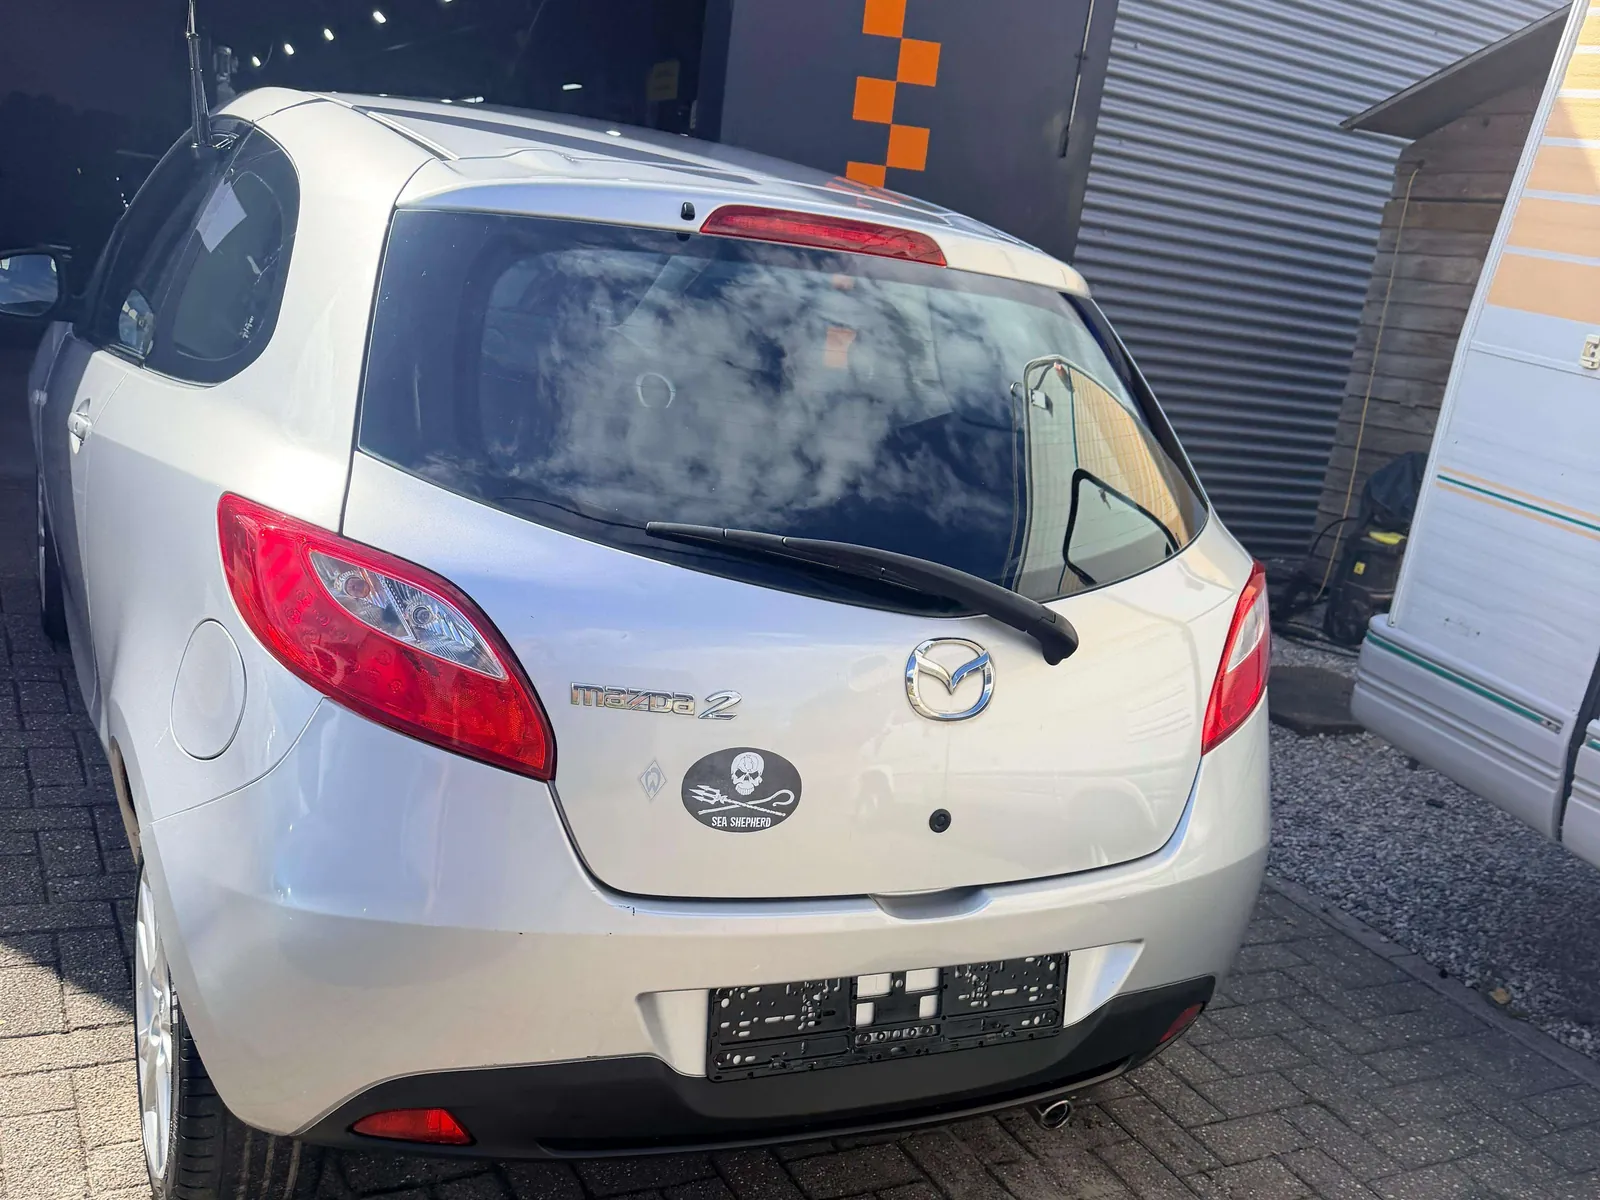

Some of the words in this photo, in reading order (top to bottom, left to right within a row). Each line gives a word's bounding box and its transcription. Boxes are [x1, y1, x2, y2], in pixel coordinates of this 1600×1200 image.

[698, 690, 742, 720] 2
[711, 816, 728, 827] SEA
[730, 816, 772, 828] SHEPHERD
